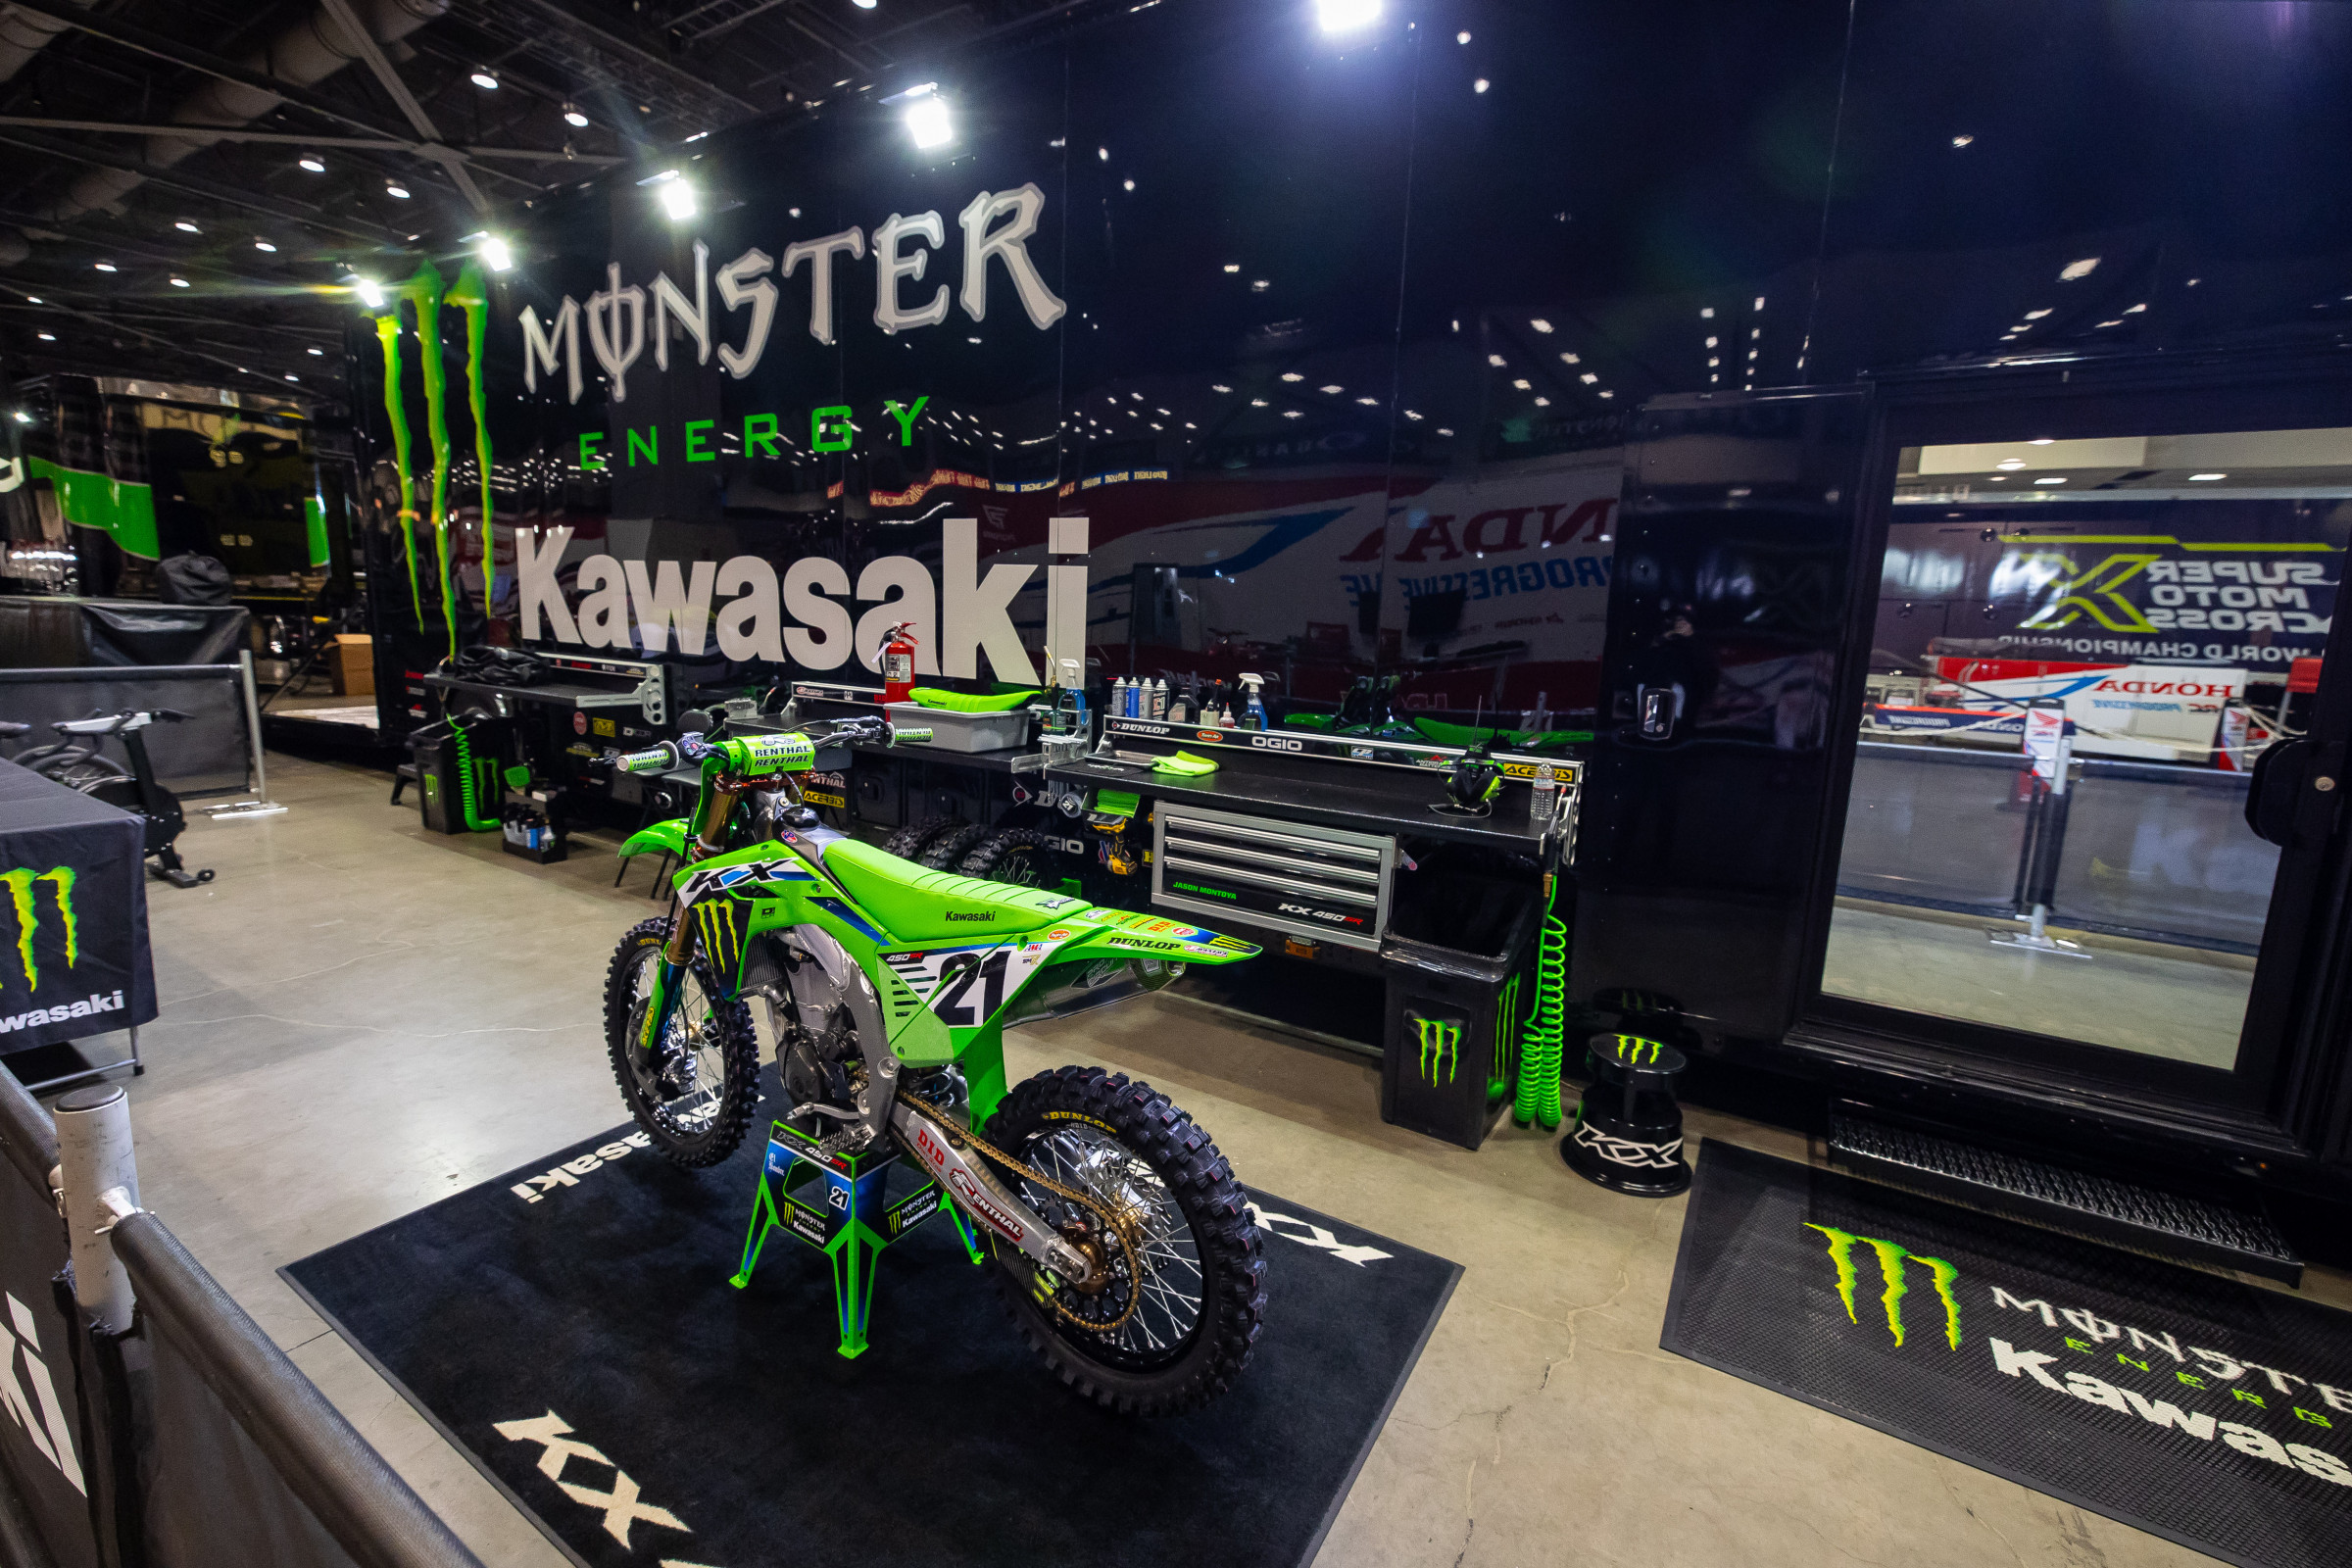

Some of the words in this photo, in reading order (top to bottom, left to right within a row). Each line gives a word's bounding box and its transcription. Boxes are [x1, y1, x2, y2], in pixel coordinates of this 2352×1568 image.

[518, 181, 1066, 405] MONSTER
[579, 396, 929, 471] ENERGY
[515, 516, 1090, 690] Kawasaki
[1120, 723, 1170, 735] DUNLOP
[755, 745, 811, 758] RENTHAL
[1251, 736, 1302, 751] OGIO
[755, 756, 810, 768] RENTHAL
[1044, 835, 1085, 855] GIO
[686, 858, 797, 891] KX
[1173, 881, 1199, 893] JASON
[1200, 886, 1237, 900] MONTOYA
[945, 910, 997, 922] Kawasaki
[1277, 903, 1313, 916] KX
[1107, 937, 1182, 951] DUNLOP
[934, 950, 1012, 1026] 21
[1049, 1111, 1117, 1134] DUNLOP
[1575, 1120, 1684, 1168] KX
[829, 1186, 851, 1211] 21
[902, 1200, 938, 1229] Kawasaki
[794, 1220, 825, 1245] Kawasaki
[2065, 1336, 2332, 1429] ENERG
[492, 1408, 692, 1552] KX
